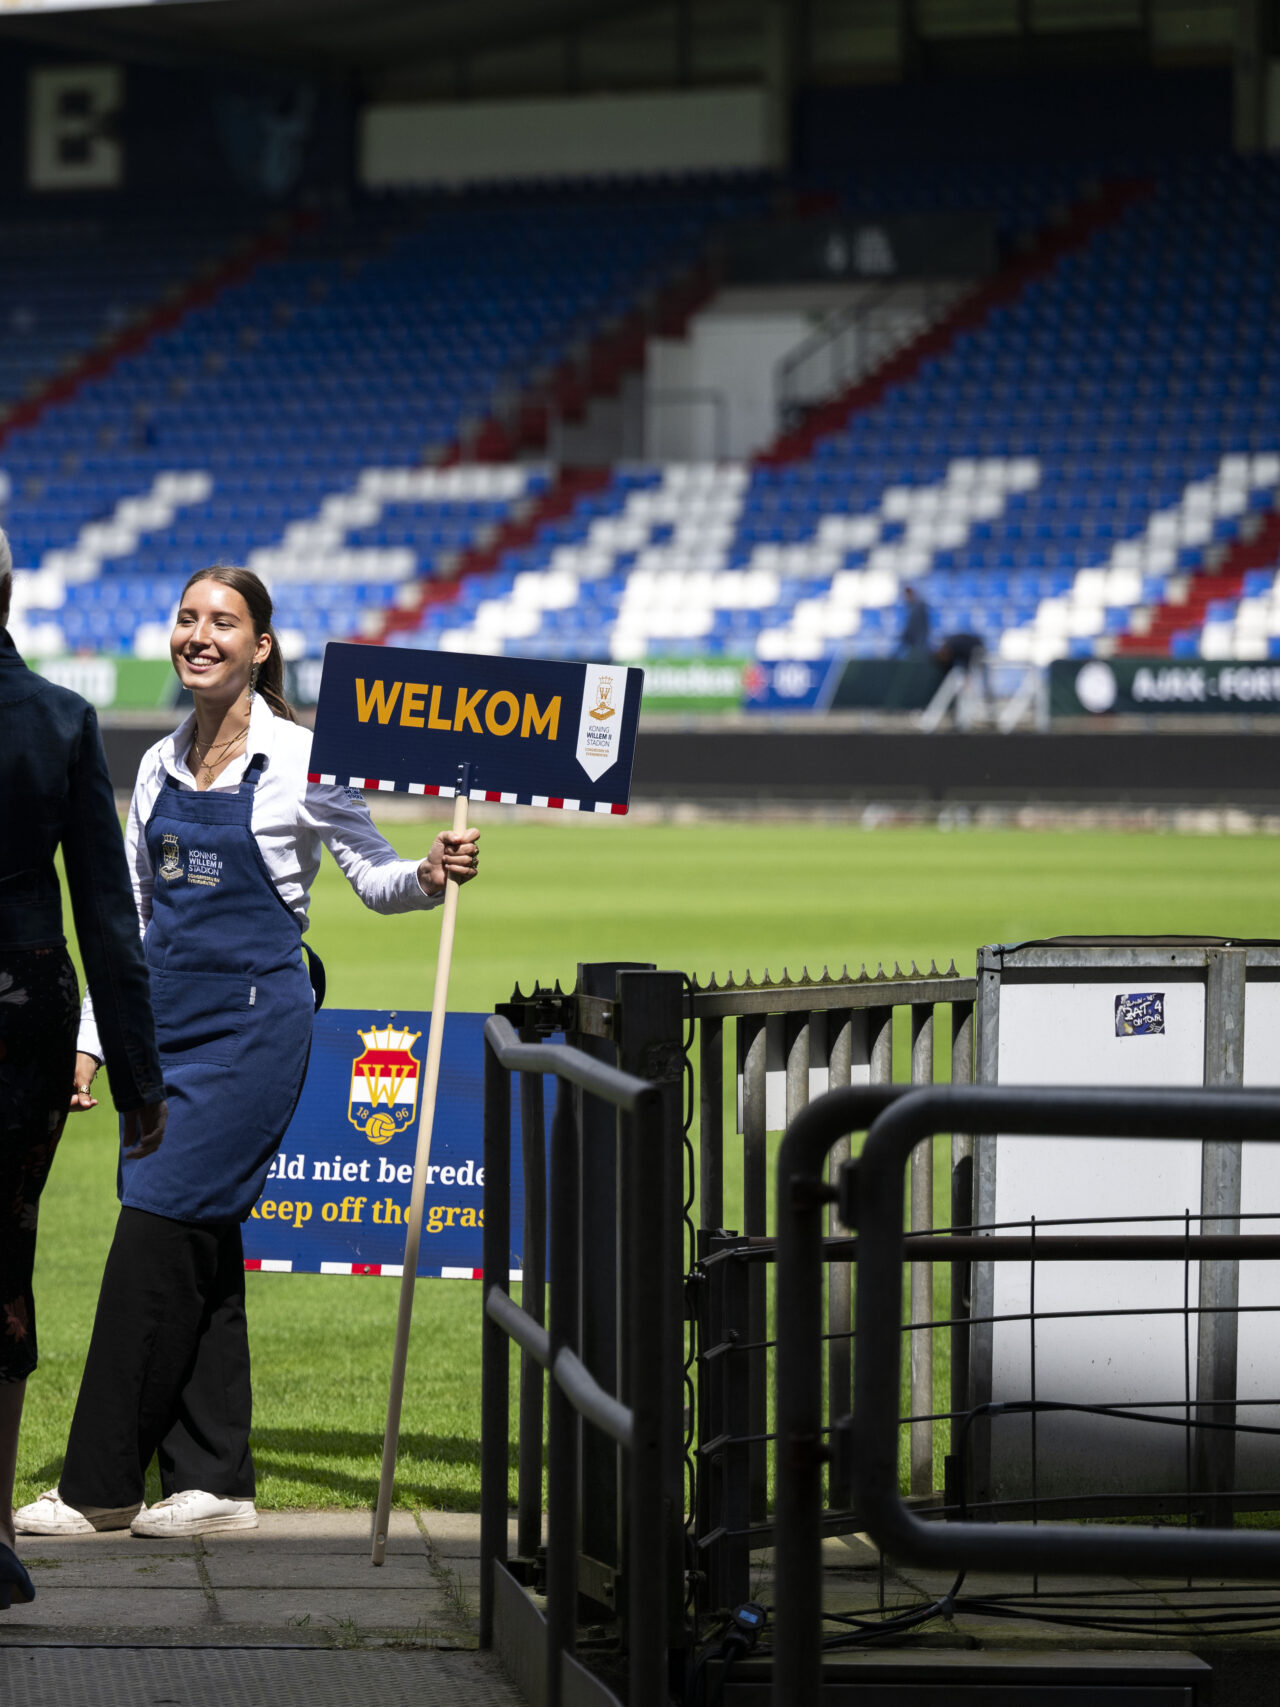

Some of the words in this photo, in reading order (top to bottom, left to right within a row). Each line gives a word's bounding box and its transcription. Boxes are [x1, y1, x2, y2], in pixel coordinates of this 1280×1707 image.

[26, 64, 124, 192] B
[355, 678, 562, 740] WELKOM
[589, 725, 610, 733] KONING
[189, 850, 217, 860] KONING
[189, 857, 217, 868] WILLEM
[188, 865, 219, 876] STADION
[359, 1064, 414, 1108] W
[356, 1106, 370, 1120] 18
[395, 1107, 410, 1122] 96
[267, 1153, 305, 1180] eld
[312, 1155, 370, 1183] niet
[377, 1157, 486, 1186] berede
[322, 1197, 368, 1223] off
